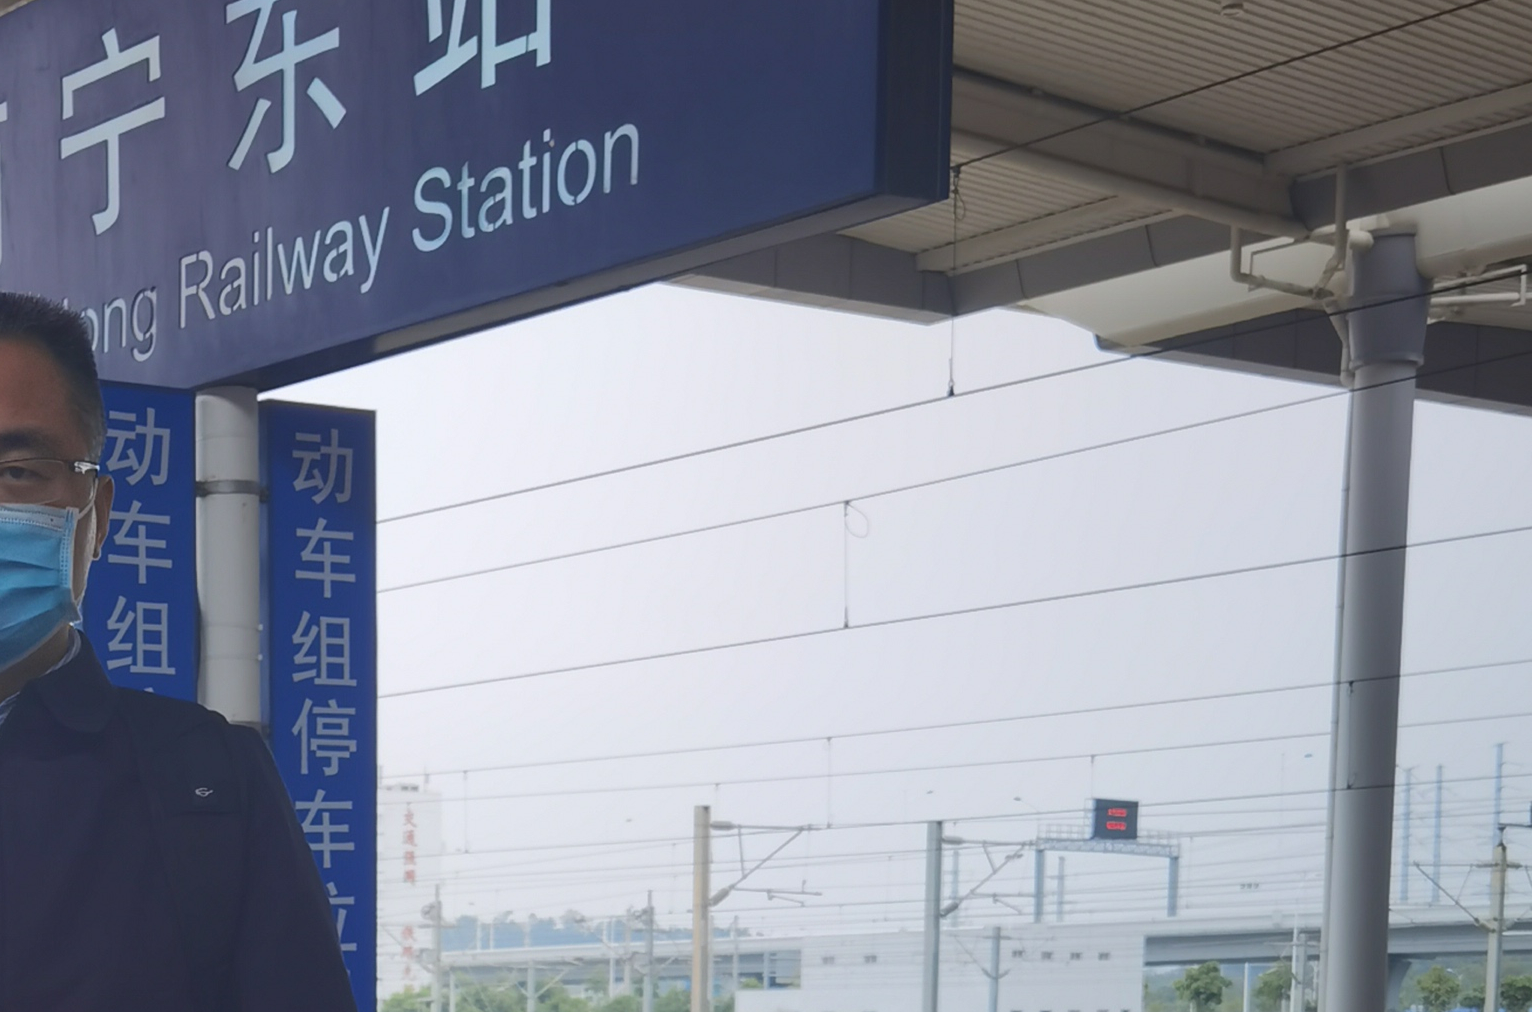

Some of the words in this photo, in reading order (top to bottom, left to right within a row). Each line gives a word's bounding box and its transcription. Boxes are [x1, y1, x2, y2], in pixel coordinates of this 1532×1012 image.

[179, 206, 390, 330] Railway
[411, 122, 640, 253] Station
[106, 407, 176, 690] 动车组
